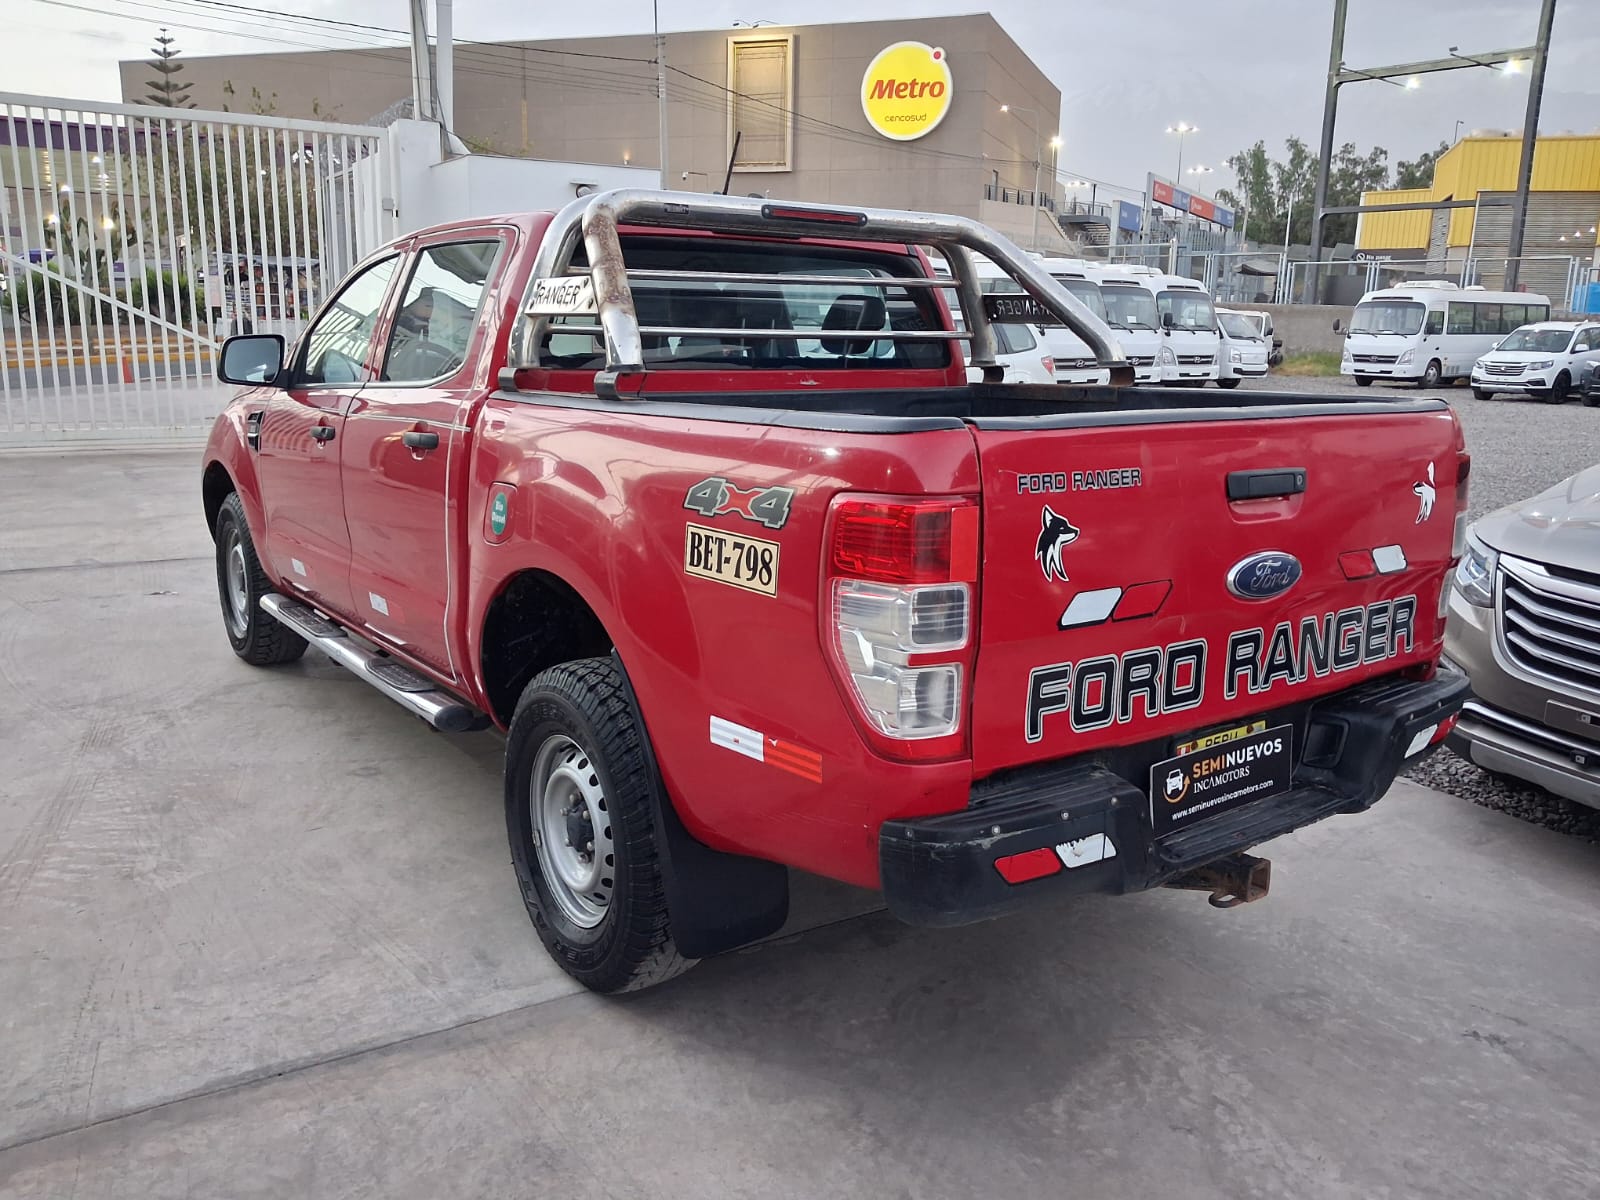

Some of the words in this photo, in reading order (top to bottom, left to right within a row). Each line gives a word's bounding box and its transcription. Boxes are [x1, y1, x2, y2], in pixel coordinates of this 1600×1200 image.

[869, 78, 945, 100] Metro
[884, 113, 927, 122] cencosud
[535, 284, 581, 305] RANGER
[1017, 472, 1067, 494] FORD
[1071, 467, 1142, 491] RANGER
[689, 531, 774, 586] BET-798
[1250, 559, 1292, 591] Ford
[1025, 638, 1208, 744] FORD
[1224, 594, 1418, 700] RANGER
[1192, 738, 1283, 778] SEMINUEVOS
[1193, 766, 1251, 794] INCAMOTORS
[1172, 779, 1274, 821] www.seminuevosincamotors.com
